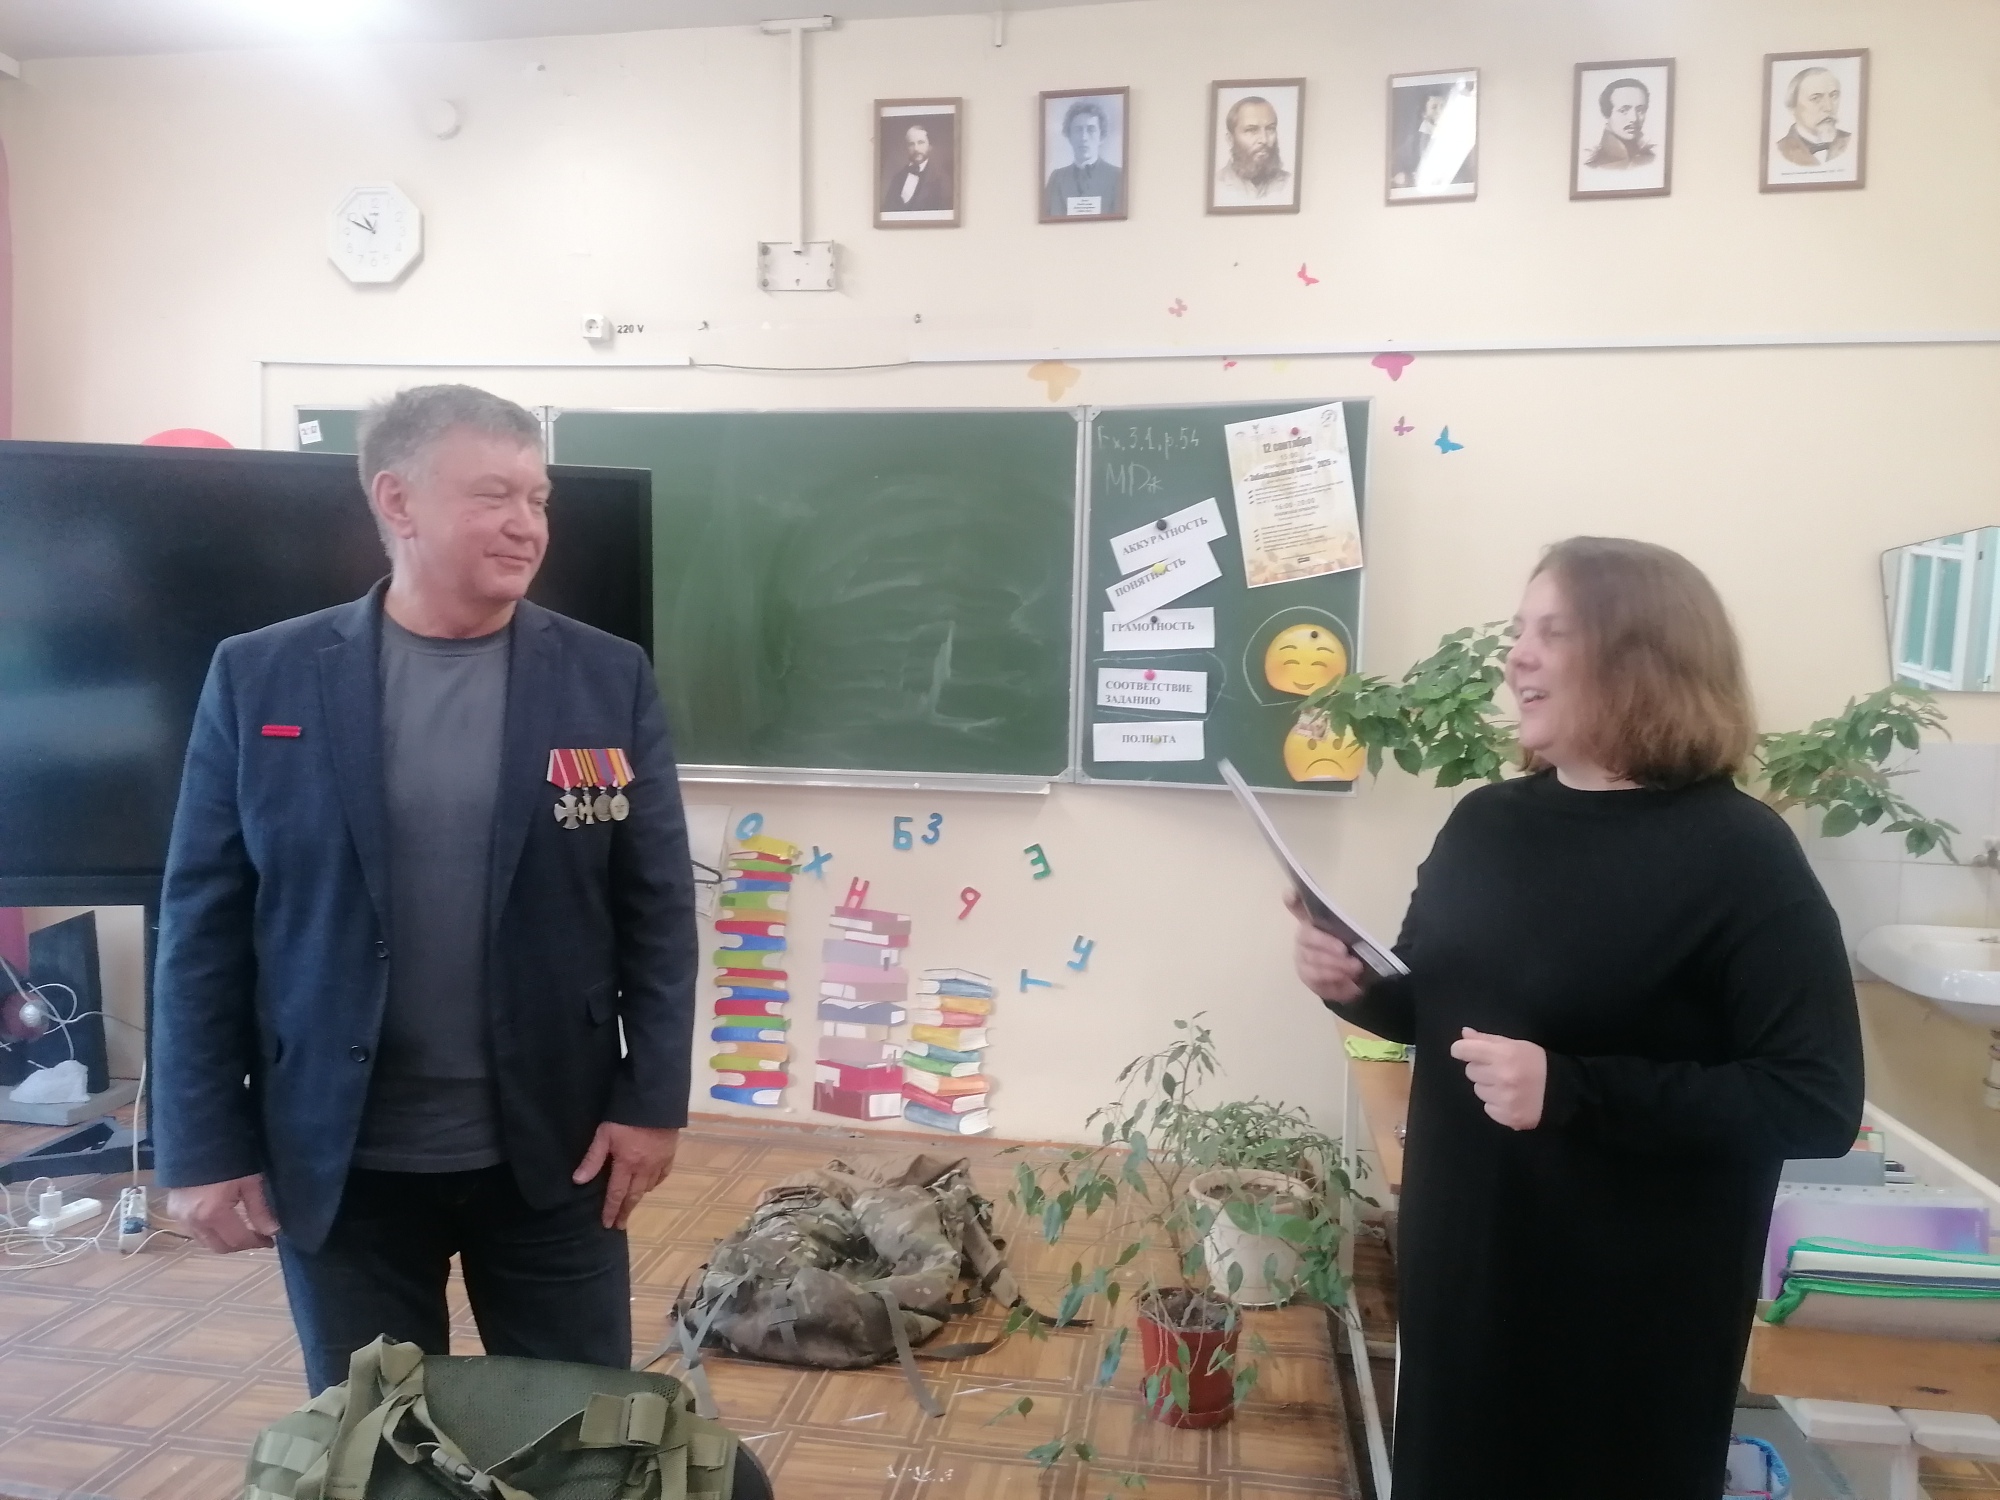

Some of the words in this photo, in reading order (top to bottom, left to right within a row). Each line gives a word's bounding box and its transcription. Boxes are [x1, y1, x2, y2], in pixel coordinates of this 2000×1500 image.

[616, 324, 634, 334] 220
[637, 324, 645, 334] V
[1122, 517, 1208, 555] АККУРАТНОСТЬ
[1105, 680, 1193, 693] СООТВЕТСТВИЕ
[1105, 695, 1161, 706] ЗАДАНИЮ
